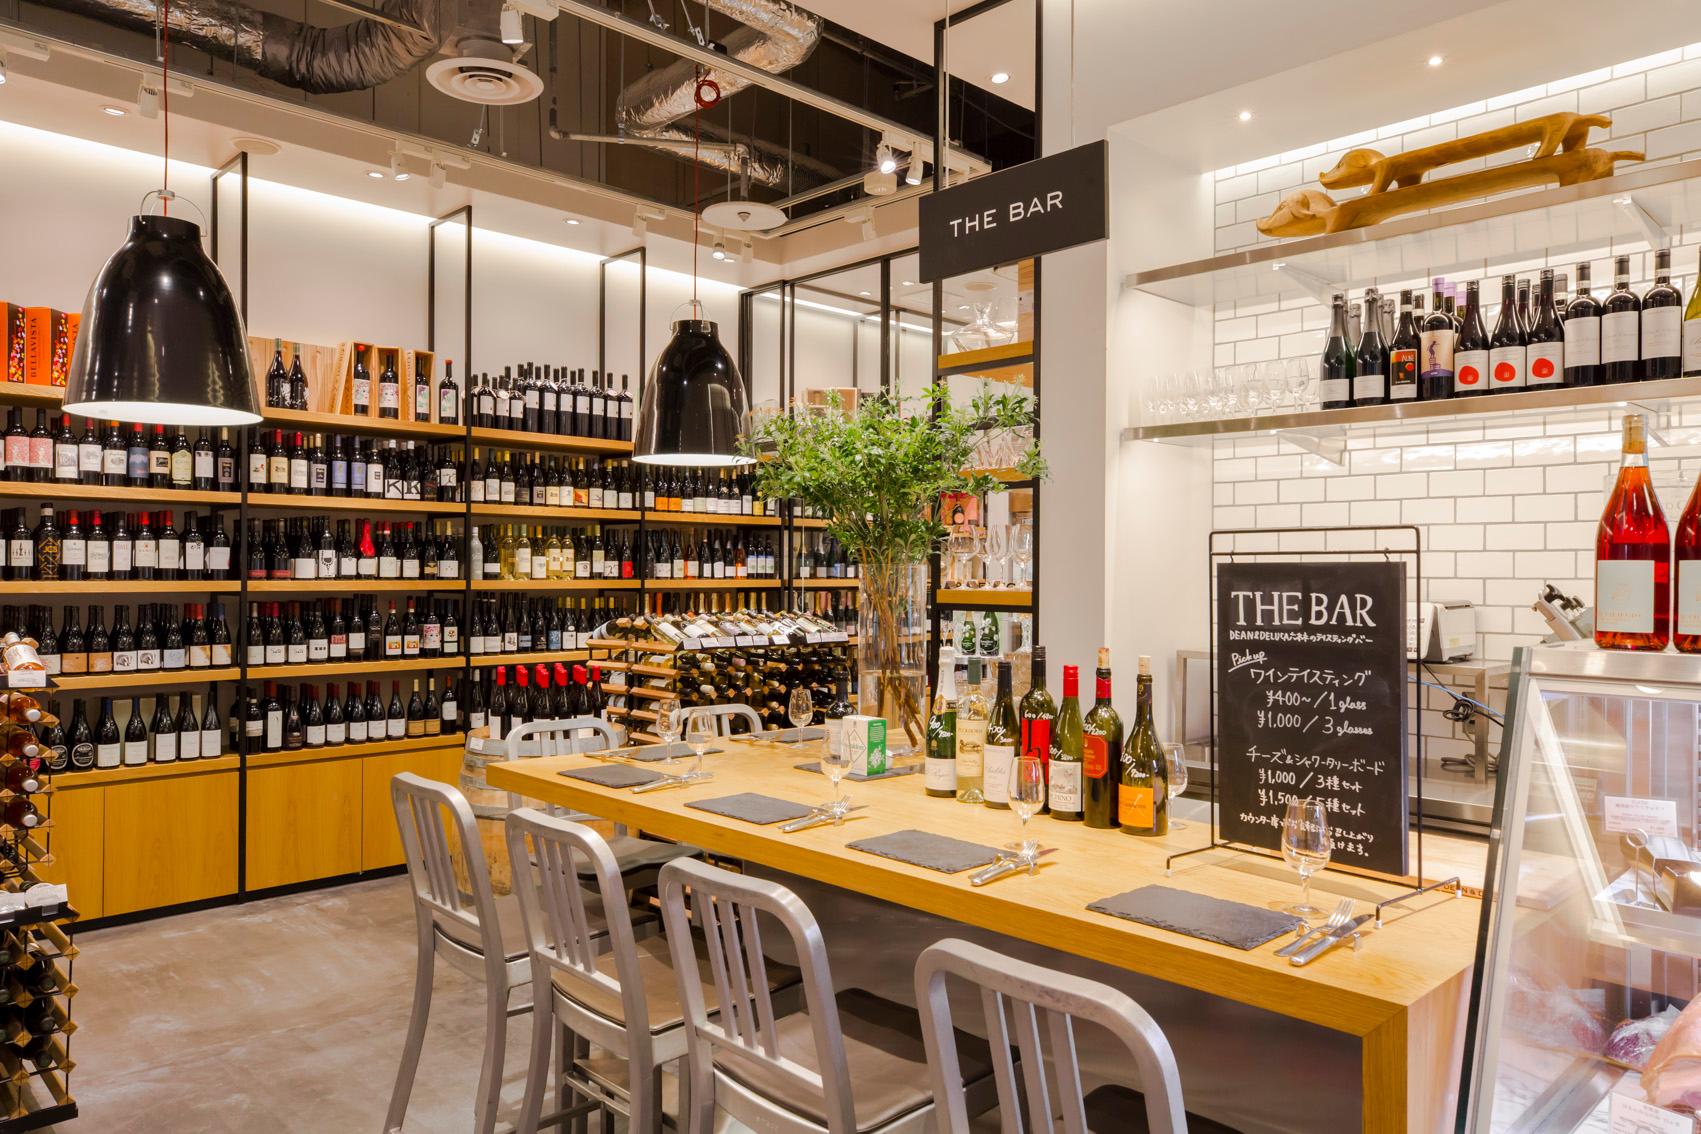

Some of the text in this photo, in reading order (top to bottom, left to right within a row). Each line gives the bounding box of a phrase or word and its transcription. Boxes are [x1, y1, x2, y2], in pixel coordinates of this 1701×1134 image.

[949, 190, 1063, 237] THE BAR
[1231, 591, 1377, 627] THE BAR
[1250, 667, 1372, 687] ワインテイスティング
[1338, 696, 1367, 712] glass
[1336, 720, 1374, 736] glasses
